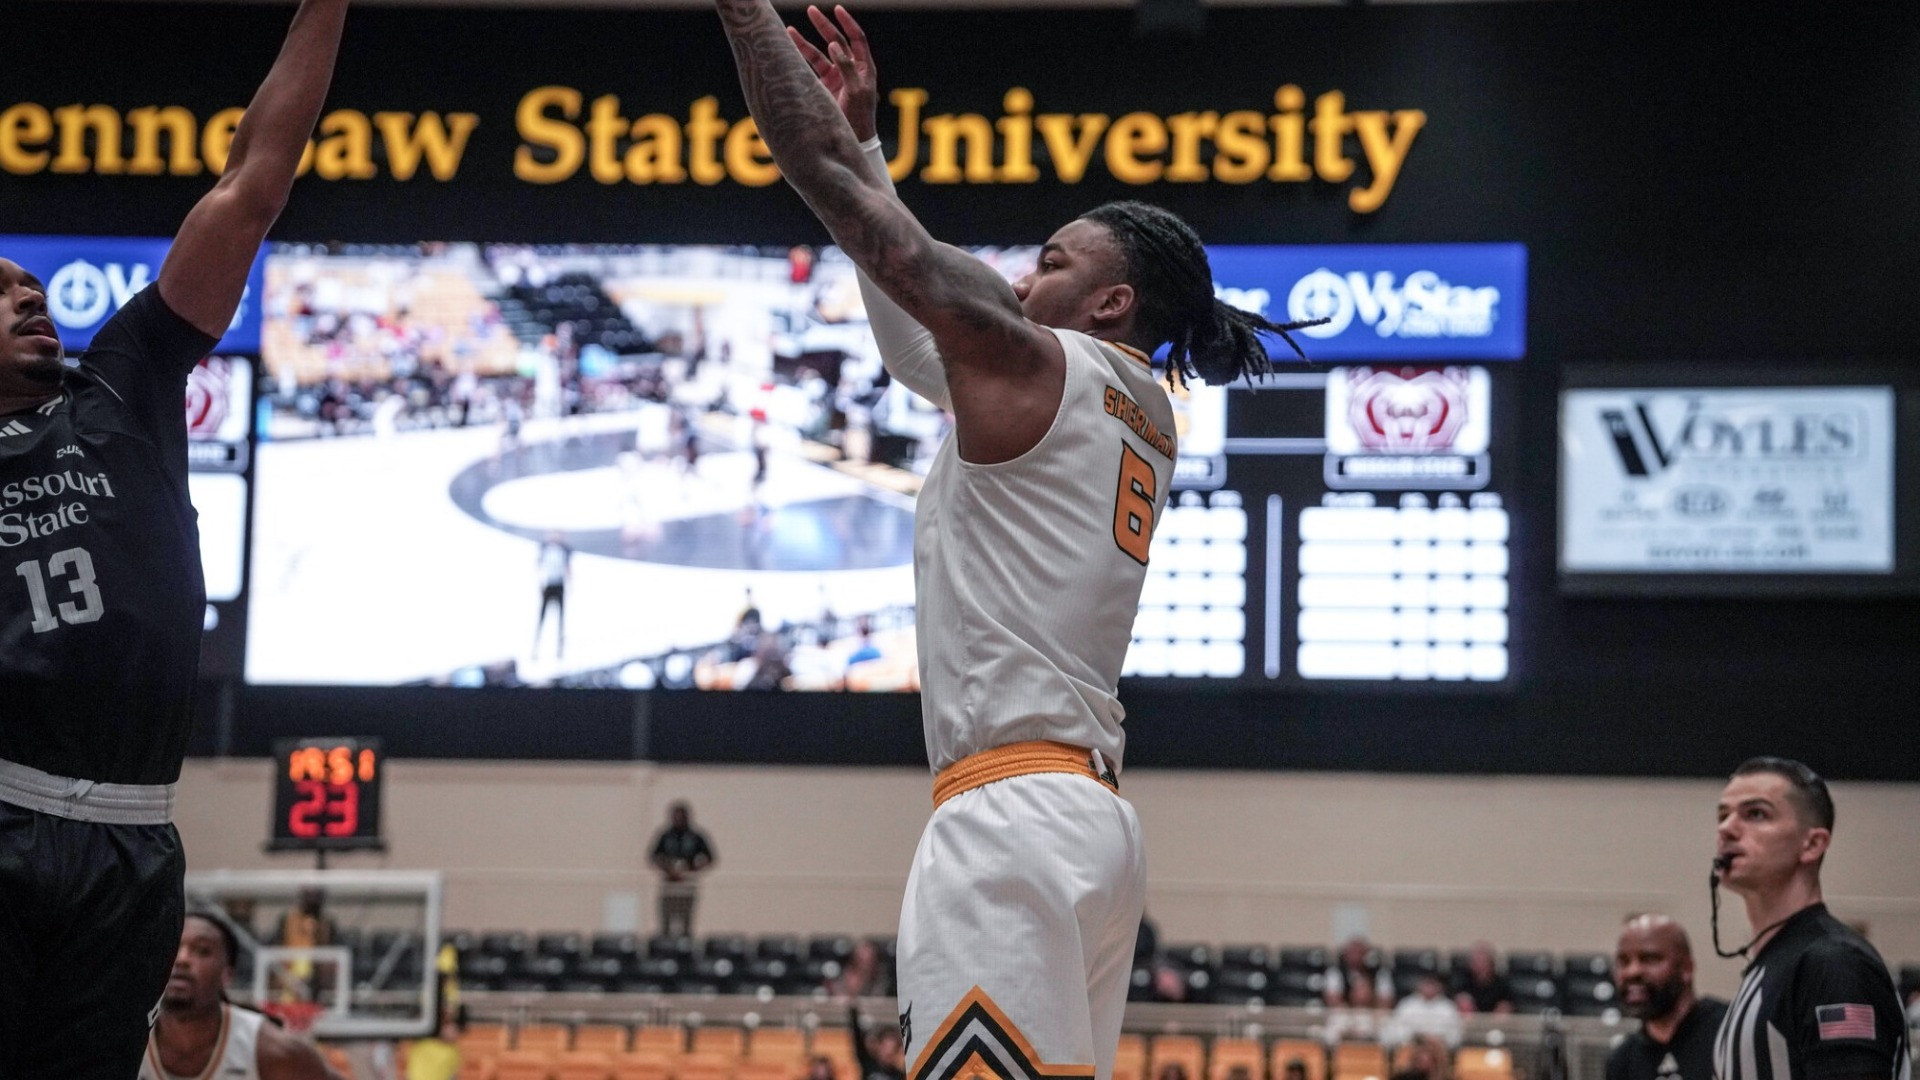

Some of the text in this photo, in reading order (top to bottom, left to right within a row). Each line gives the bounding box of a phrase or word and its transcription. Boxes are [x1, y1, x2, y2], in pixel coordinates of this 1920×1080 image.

[0, 101, 479, 181] enneaw
[513, 85, 783, 187] State
[1103, 384, 1175, 461] SHERMAN
[0, 470, 116, 511] ssouri
[0, 501, 89, 547] State
[1112, 437, 1157, 567] 6
[15, 546, 105, 634] 13
[288, 780, 359, 838] 23
